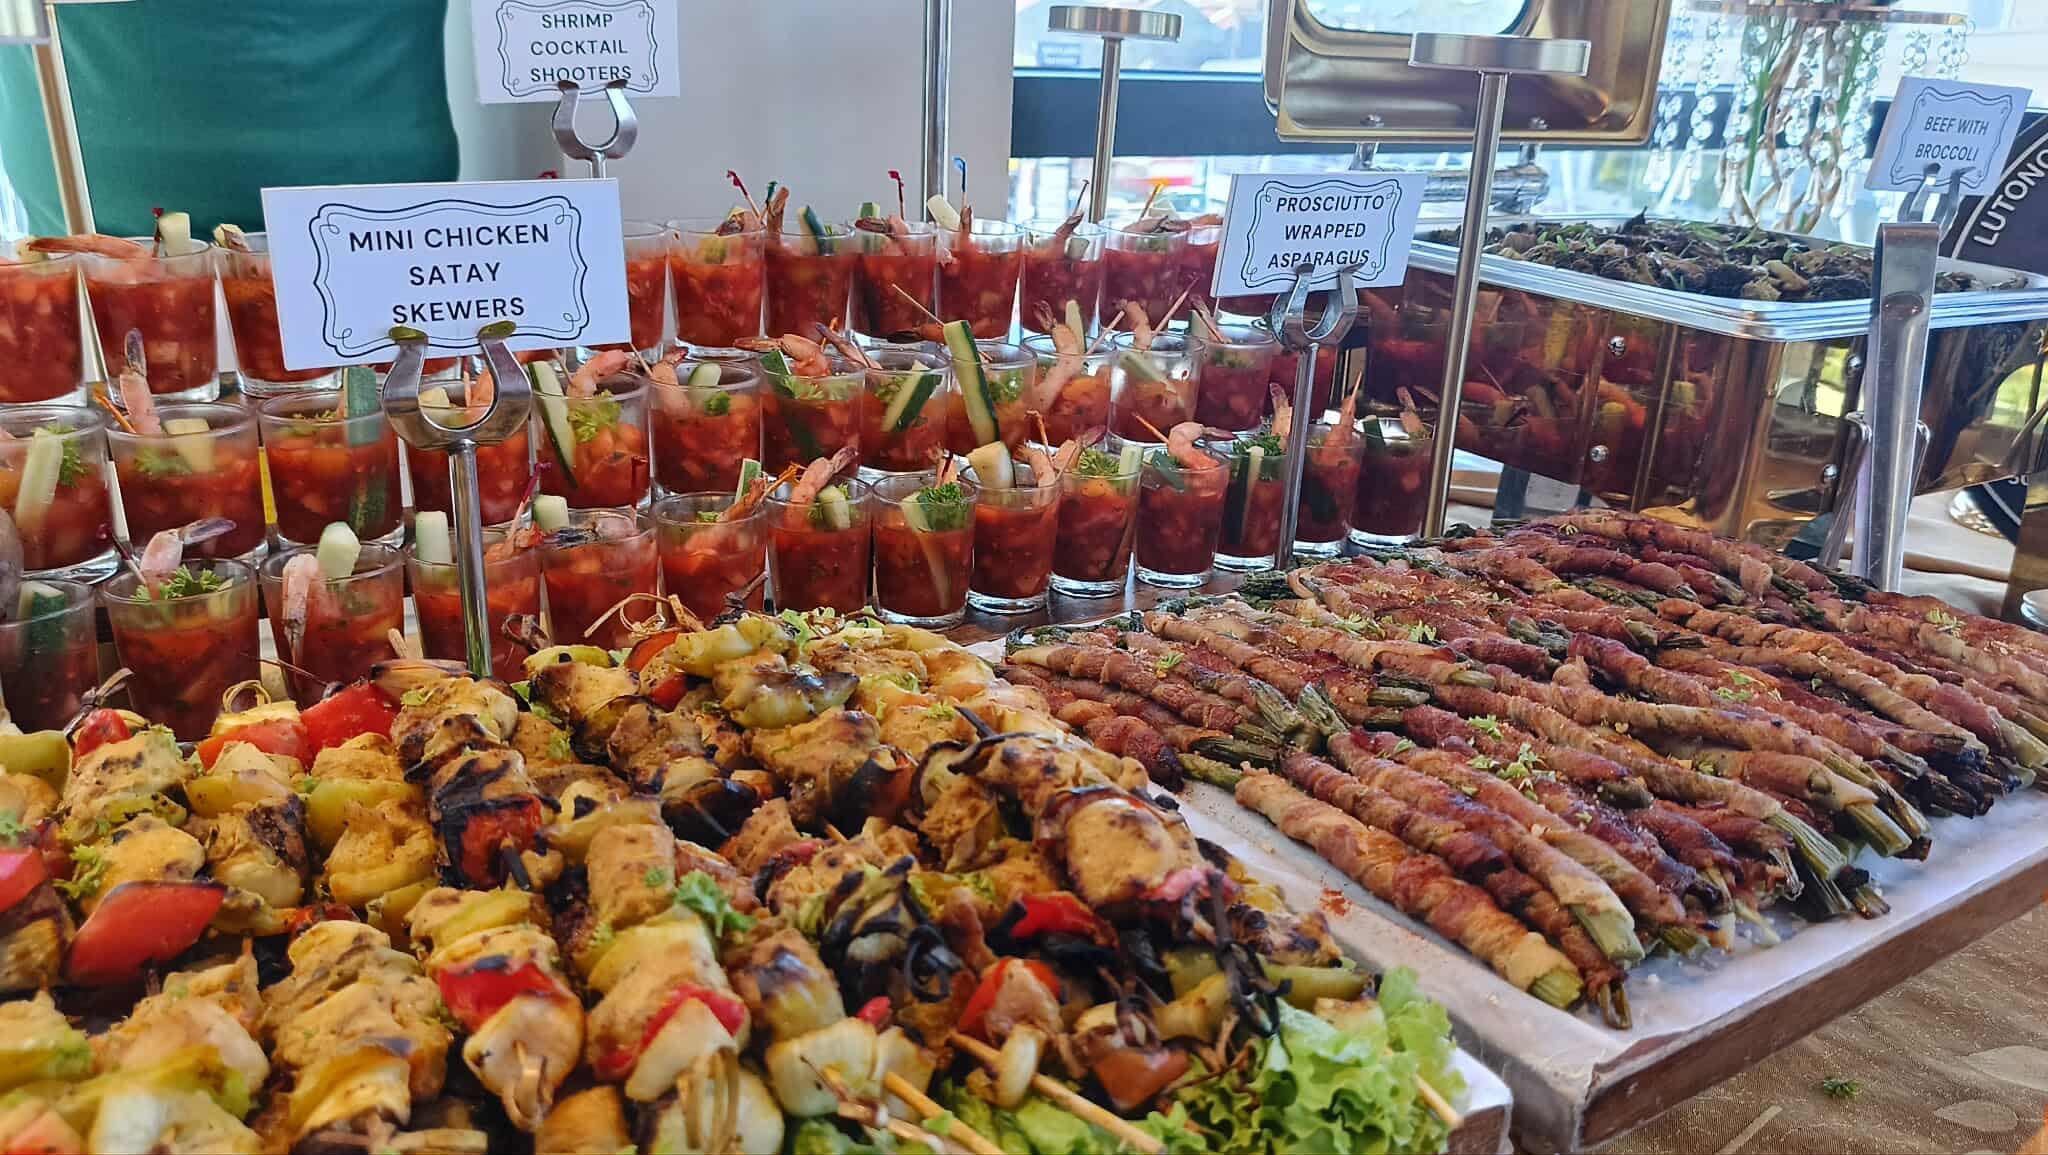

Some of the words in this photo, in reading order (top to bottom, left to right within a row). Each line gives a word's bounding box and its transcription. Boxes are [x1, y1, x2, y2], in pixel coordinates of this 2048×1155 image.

[541, 14, 613, 29] SHRIMP
[531, 40, 628, 56] COCKTAIL
[531, 66, 632, 82] SHOOTERS
[1924, 116, 1953, 133] BEEF
[1958, 119, 1990, 135] WITH
[1915, 144, 1979, 161] BROCCOLI
[1276, 195, 1385, 213] PROSCIUTTO
[350, 230, 413, 251] MINI
[424, 224, 549, 248] CHICKEN
[1285, 223, 1366, 240] WRAPPED
[1267, 250, 1370, 269] ASPARAGUS
[409, 262, 501, 286] SATAY
[392, 297, 525, 324] SKEWERS
